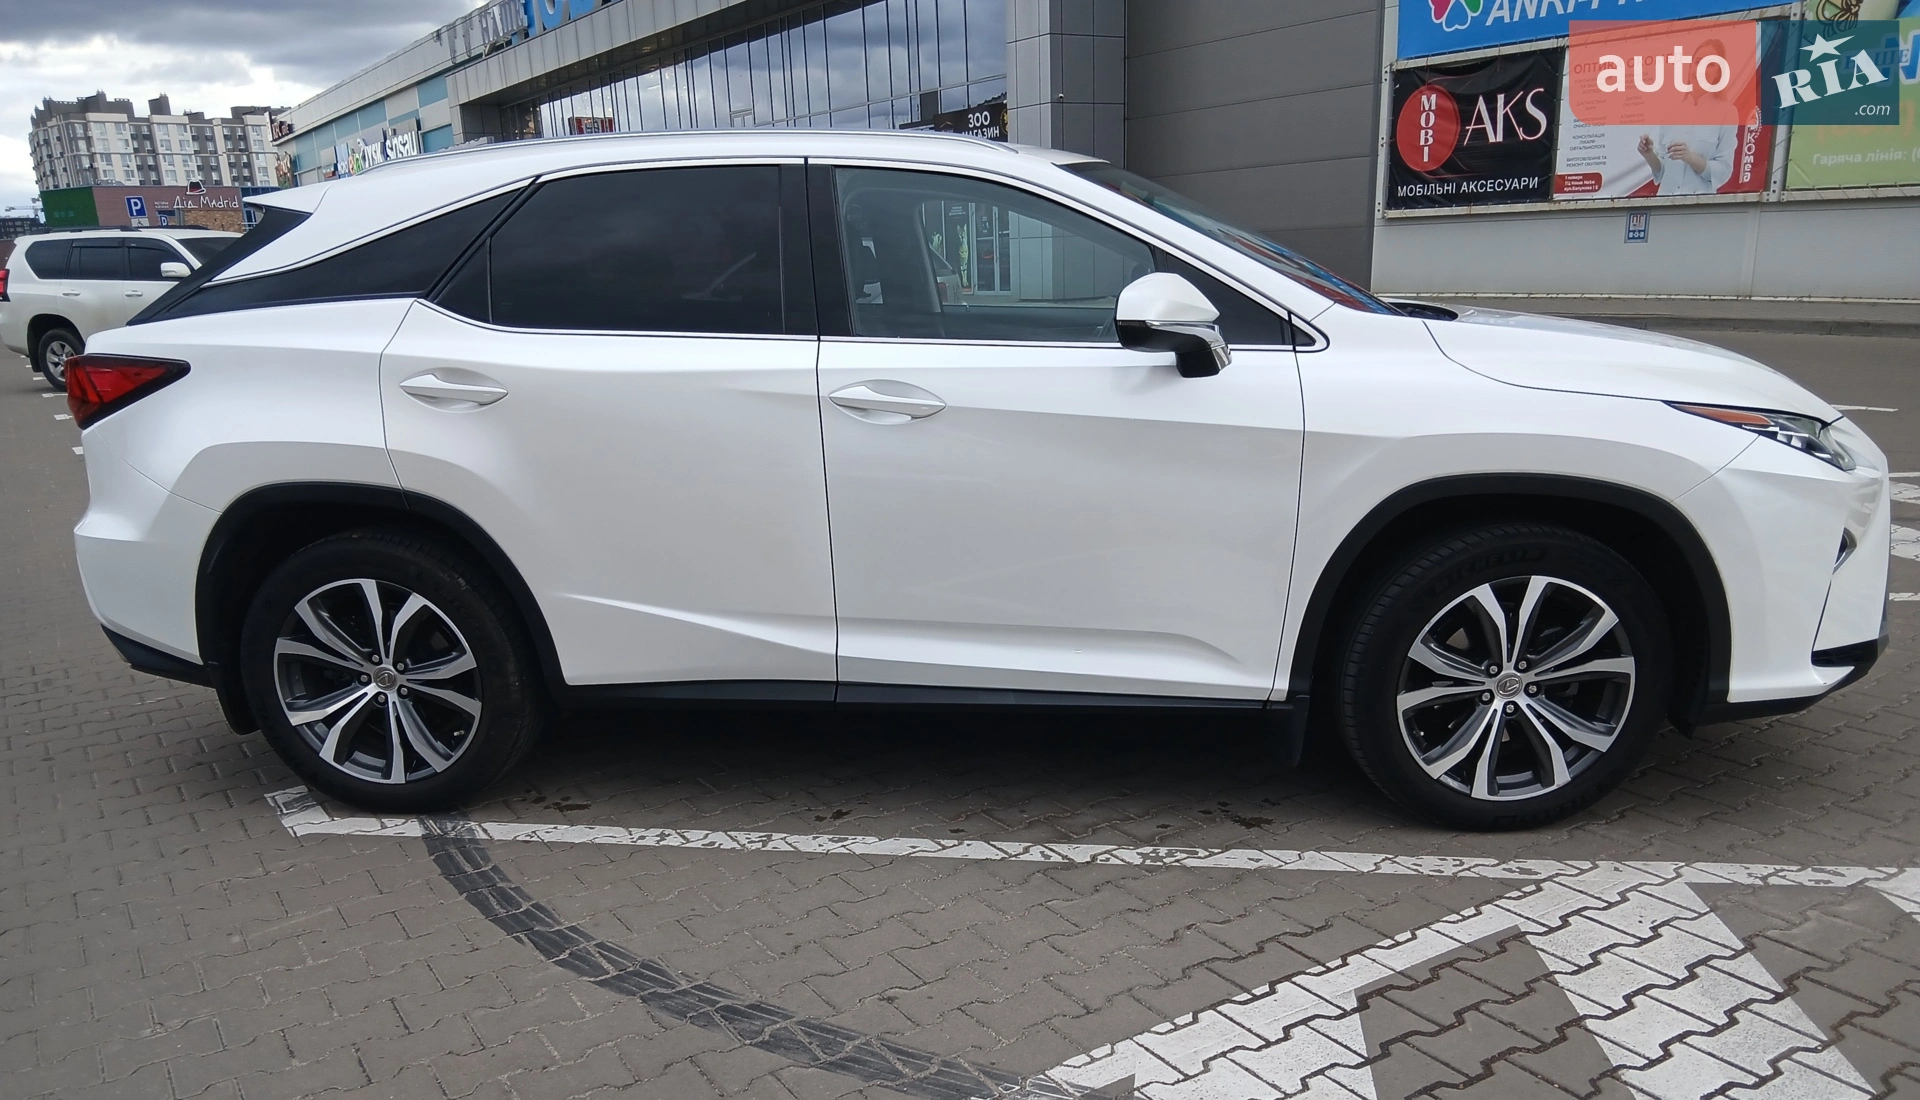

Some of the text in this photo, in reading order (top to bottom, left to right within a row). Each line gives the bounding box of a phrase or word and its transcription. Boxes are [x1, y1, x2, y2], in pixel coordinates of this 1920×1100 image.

[1463, 88, 1547, 146] AKS
[1812, 153, 1862, 167] Гаряча
[1397, 176, 1539, 197] МОБІЛЬНІ АКСЕСУАРИ
[130, 198, 142, 216] P
